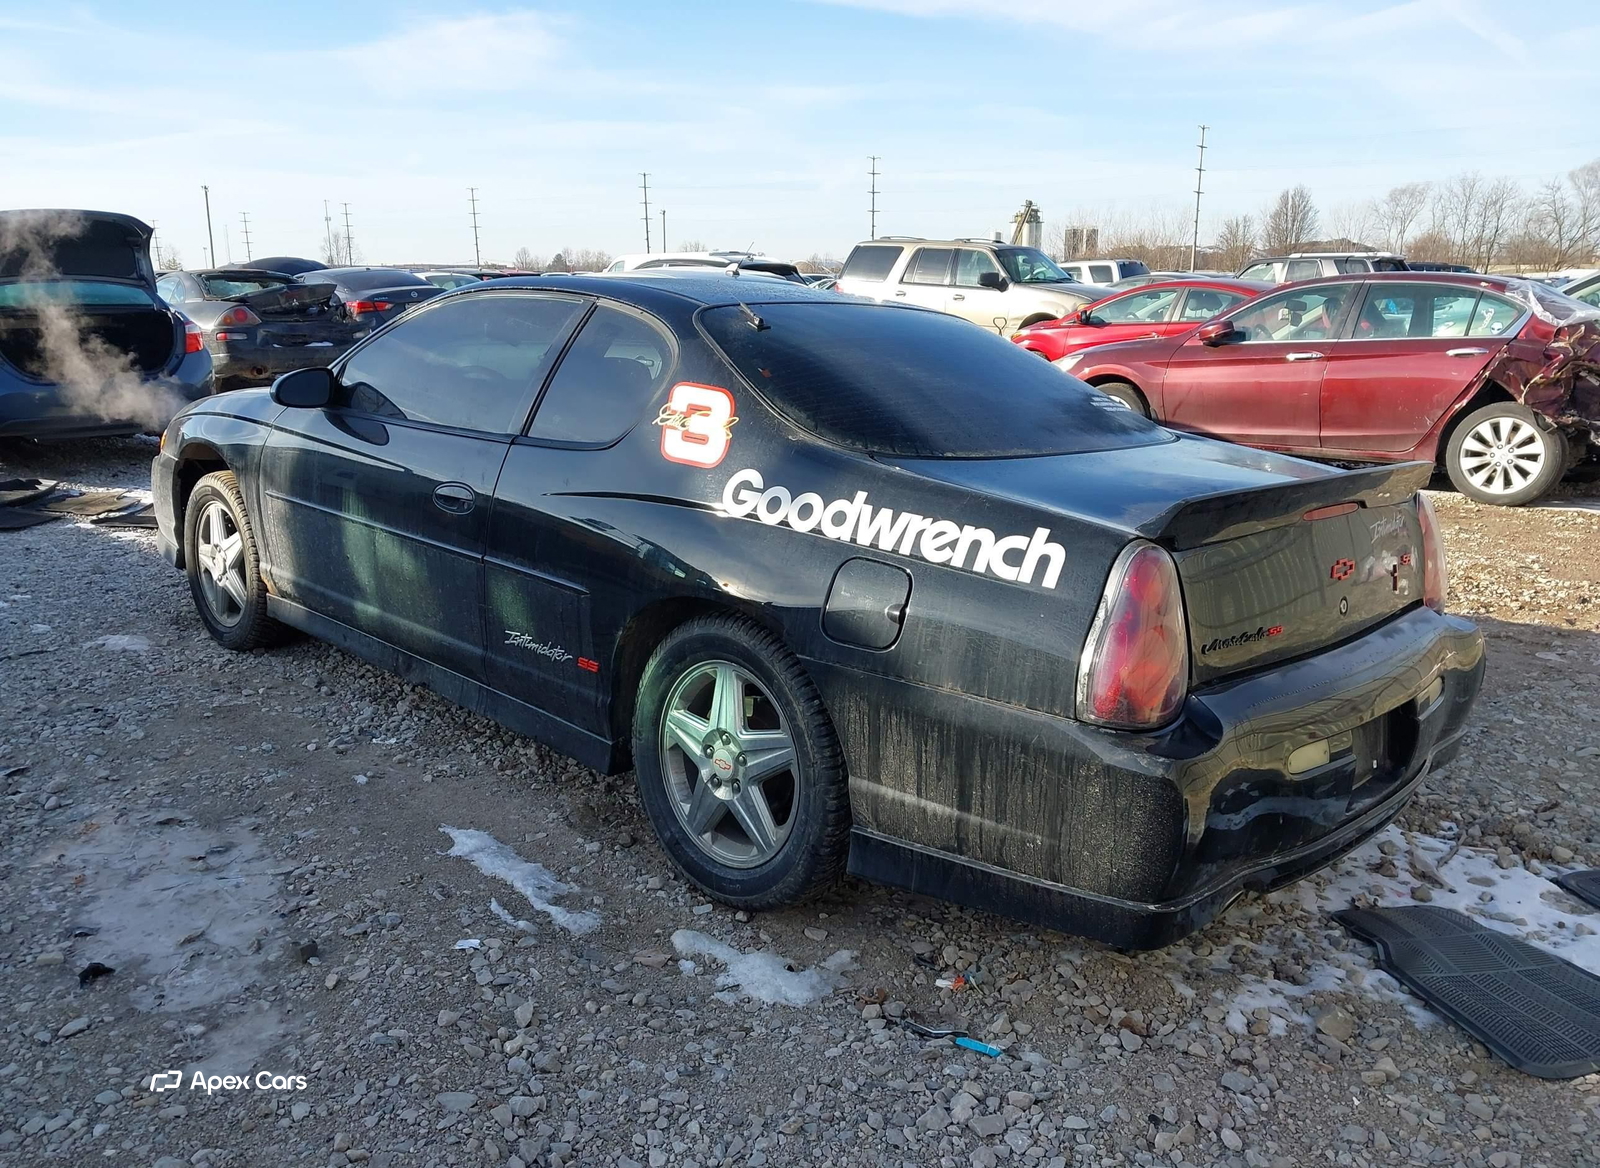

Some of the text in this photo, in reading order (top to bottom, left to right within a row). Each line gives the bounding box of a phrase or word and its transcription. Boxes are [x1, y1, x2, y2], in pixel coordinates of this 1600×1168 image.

[660, 381, 736, 469] 3
[722, 468, 1066, 589] Goodwrench
[504, 630, 600, 673] Intimidator SS
